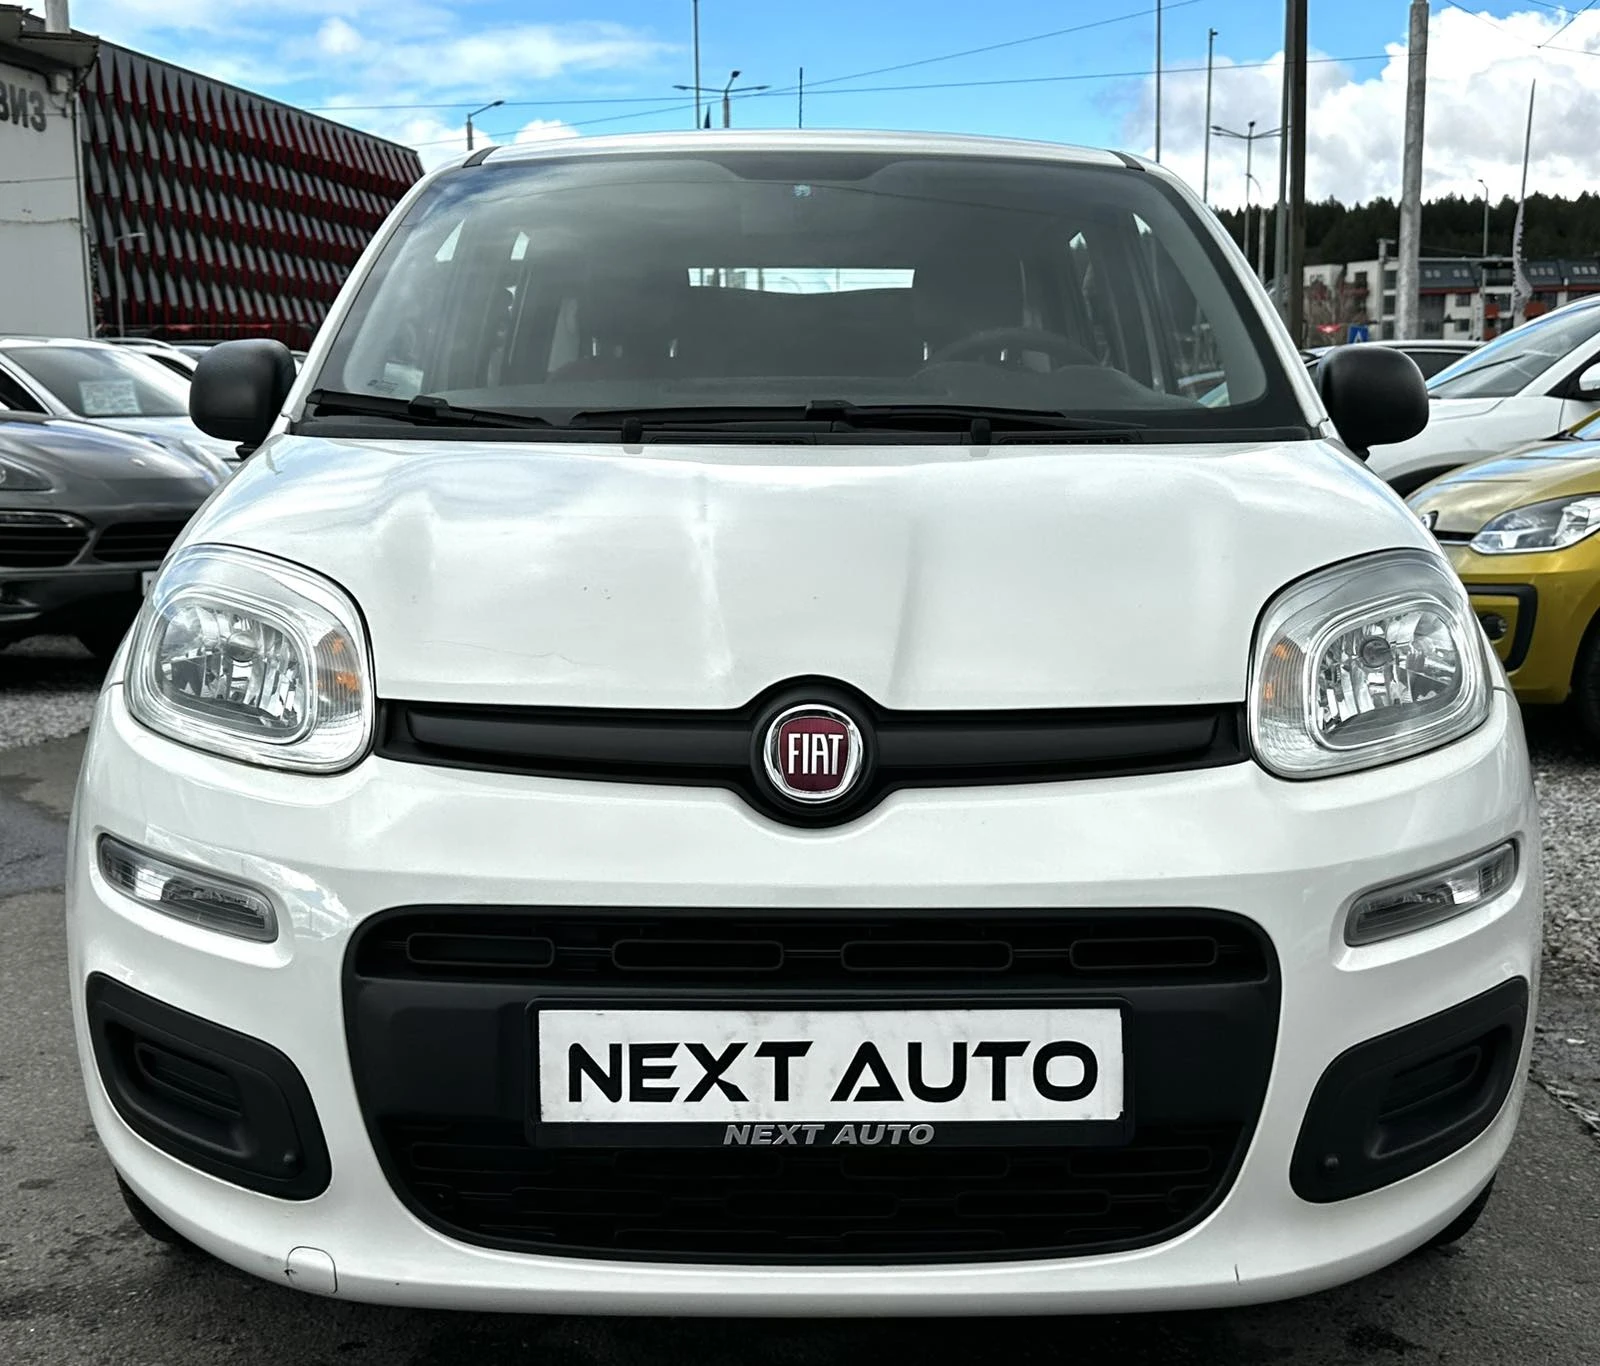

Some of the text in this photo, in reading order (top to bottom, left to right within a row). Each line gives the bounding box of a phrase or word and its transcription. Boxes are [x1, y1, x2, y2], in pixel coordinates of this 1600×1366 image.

[788, 733, 844, 775] FIAT
[569, 1041, 1099, 1103] NEXT AUTO
[723, 1124, 935, 1145] NEXT AUTO
